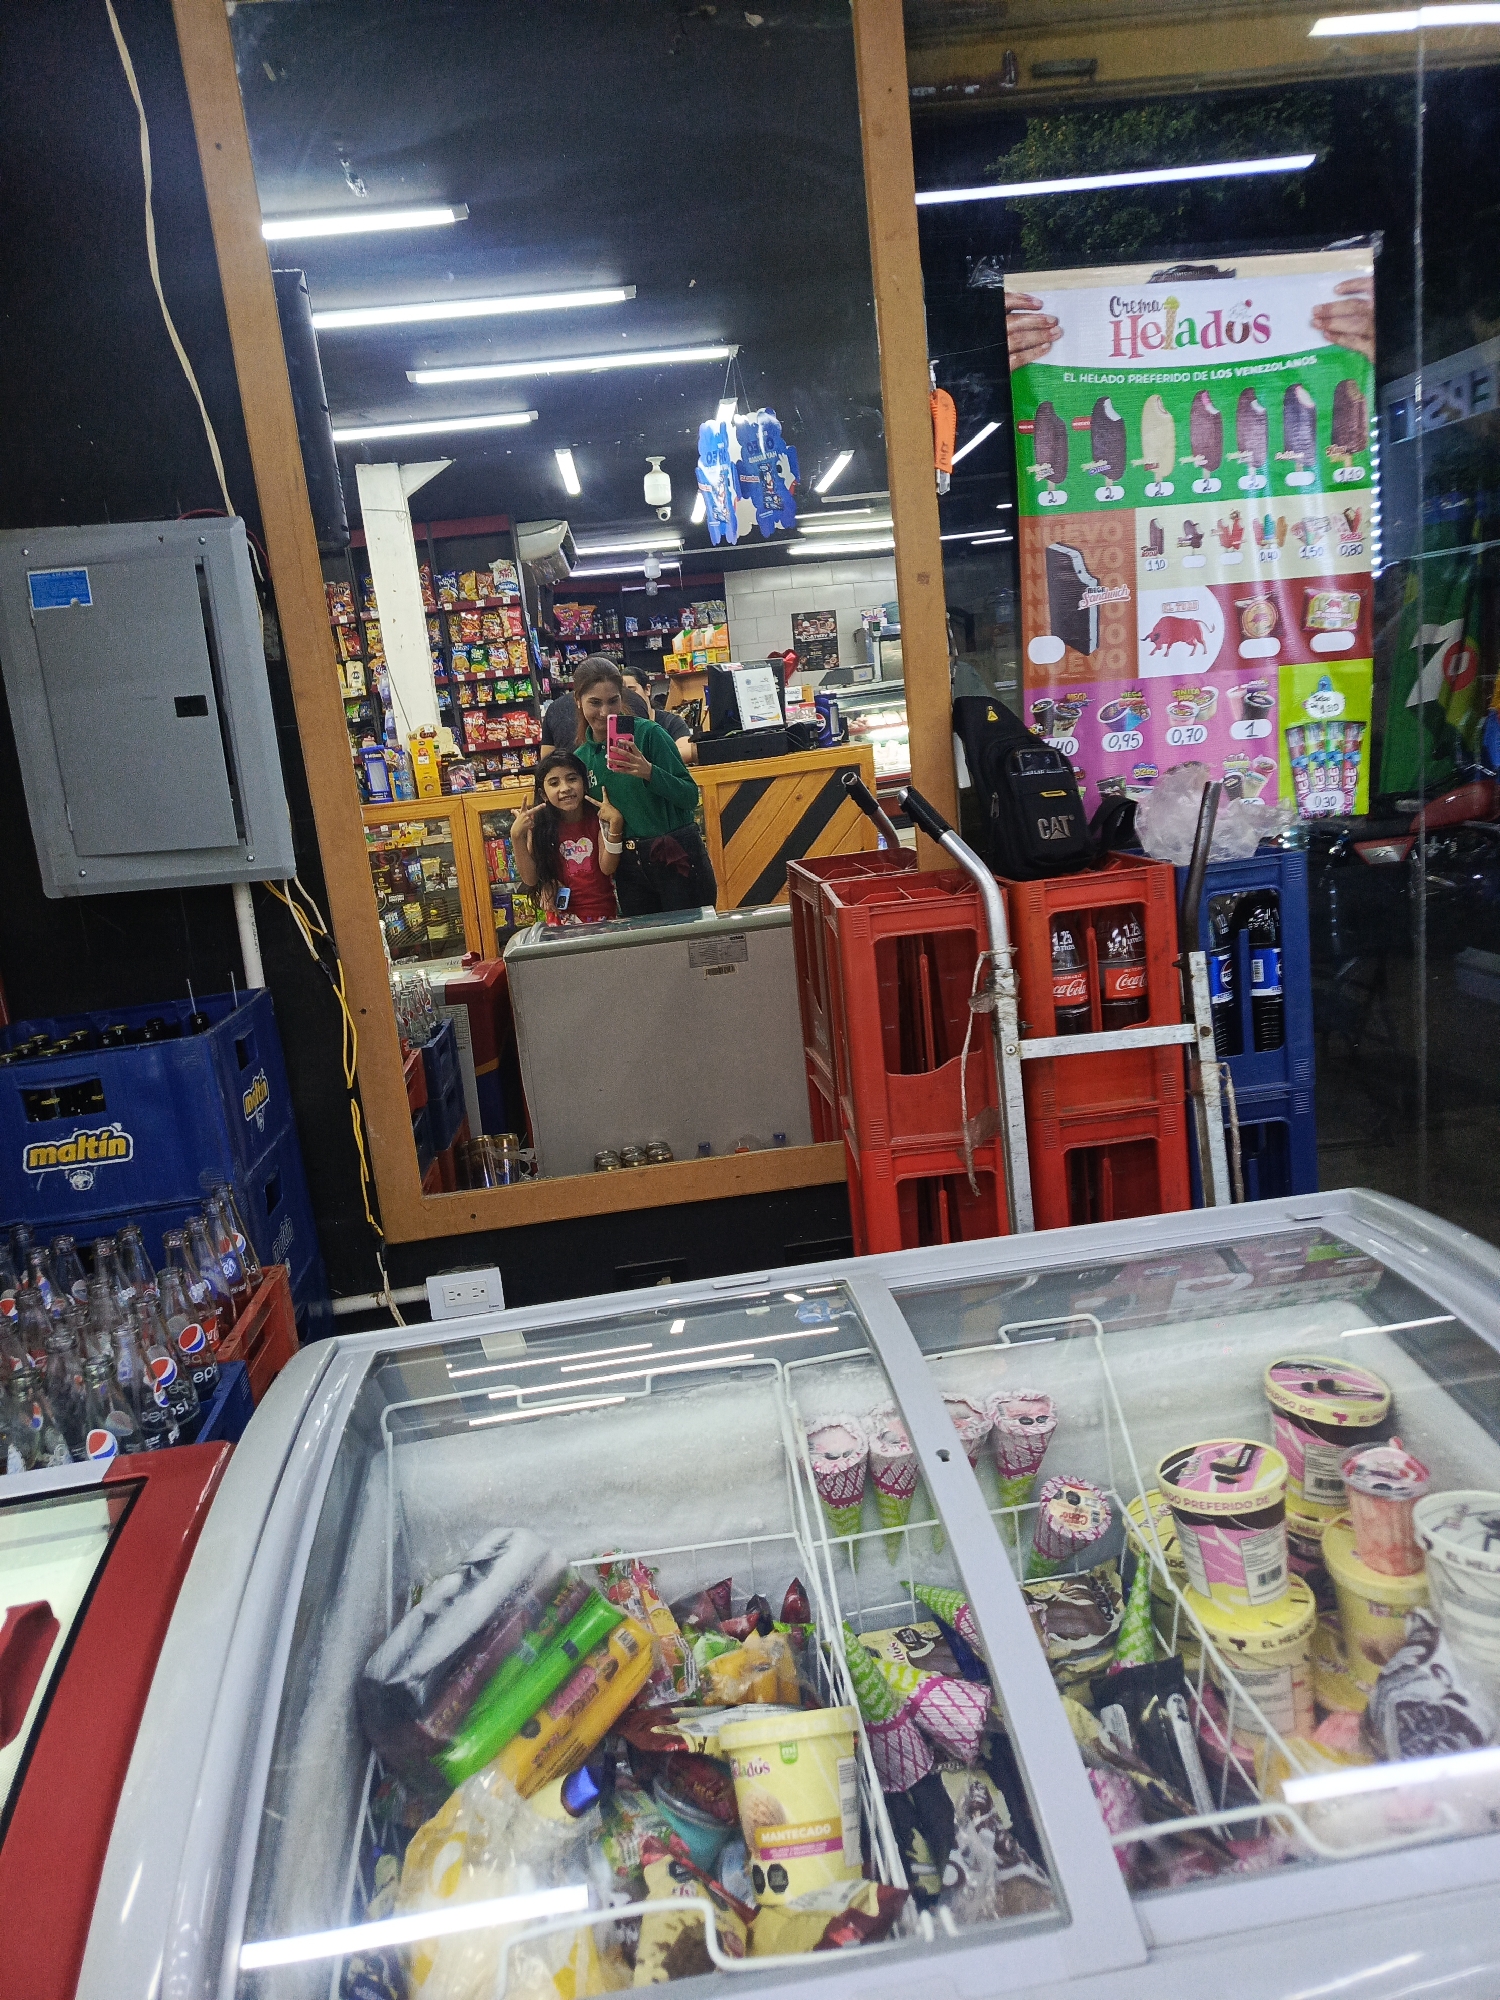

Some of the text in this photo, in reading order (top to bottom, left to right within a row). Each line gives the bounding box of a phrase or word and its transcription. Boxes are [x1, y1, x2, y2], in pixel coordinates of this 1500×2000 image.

[1108, 297, 1272, 359] Helados
[1064, 355, 1318, 384] EL HELADO PREFERIDO DE LOS VENEZOLANOS
[1105, 487, 1115, 500] 2
[1154, 482, 1165, 496] 2
[1202, 479, 1212, 492] 2
[1049, 491, 1057, 503] 2
[1171, 727, 1203, 744] 0,70
[1244, 721, 1258, 738] 1
[1108, 734, 1140, 750] 0,95
[1037, 815, 1071, 840] CAT
[1183, 1497, 1254, 1511] PREFERIDO
[1256, 1495, 1270, 1507] DE
[760, 1823, 832, 1844] MANTECADO
